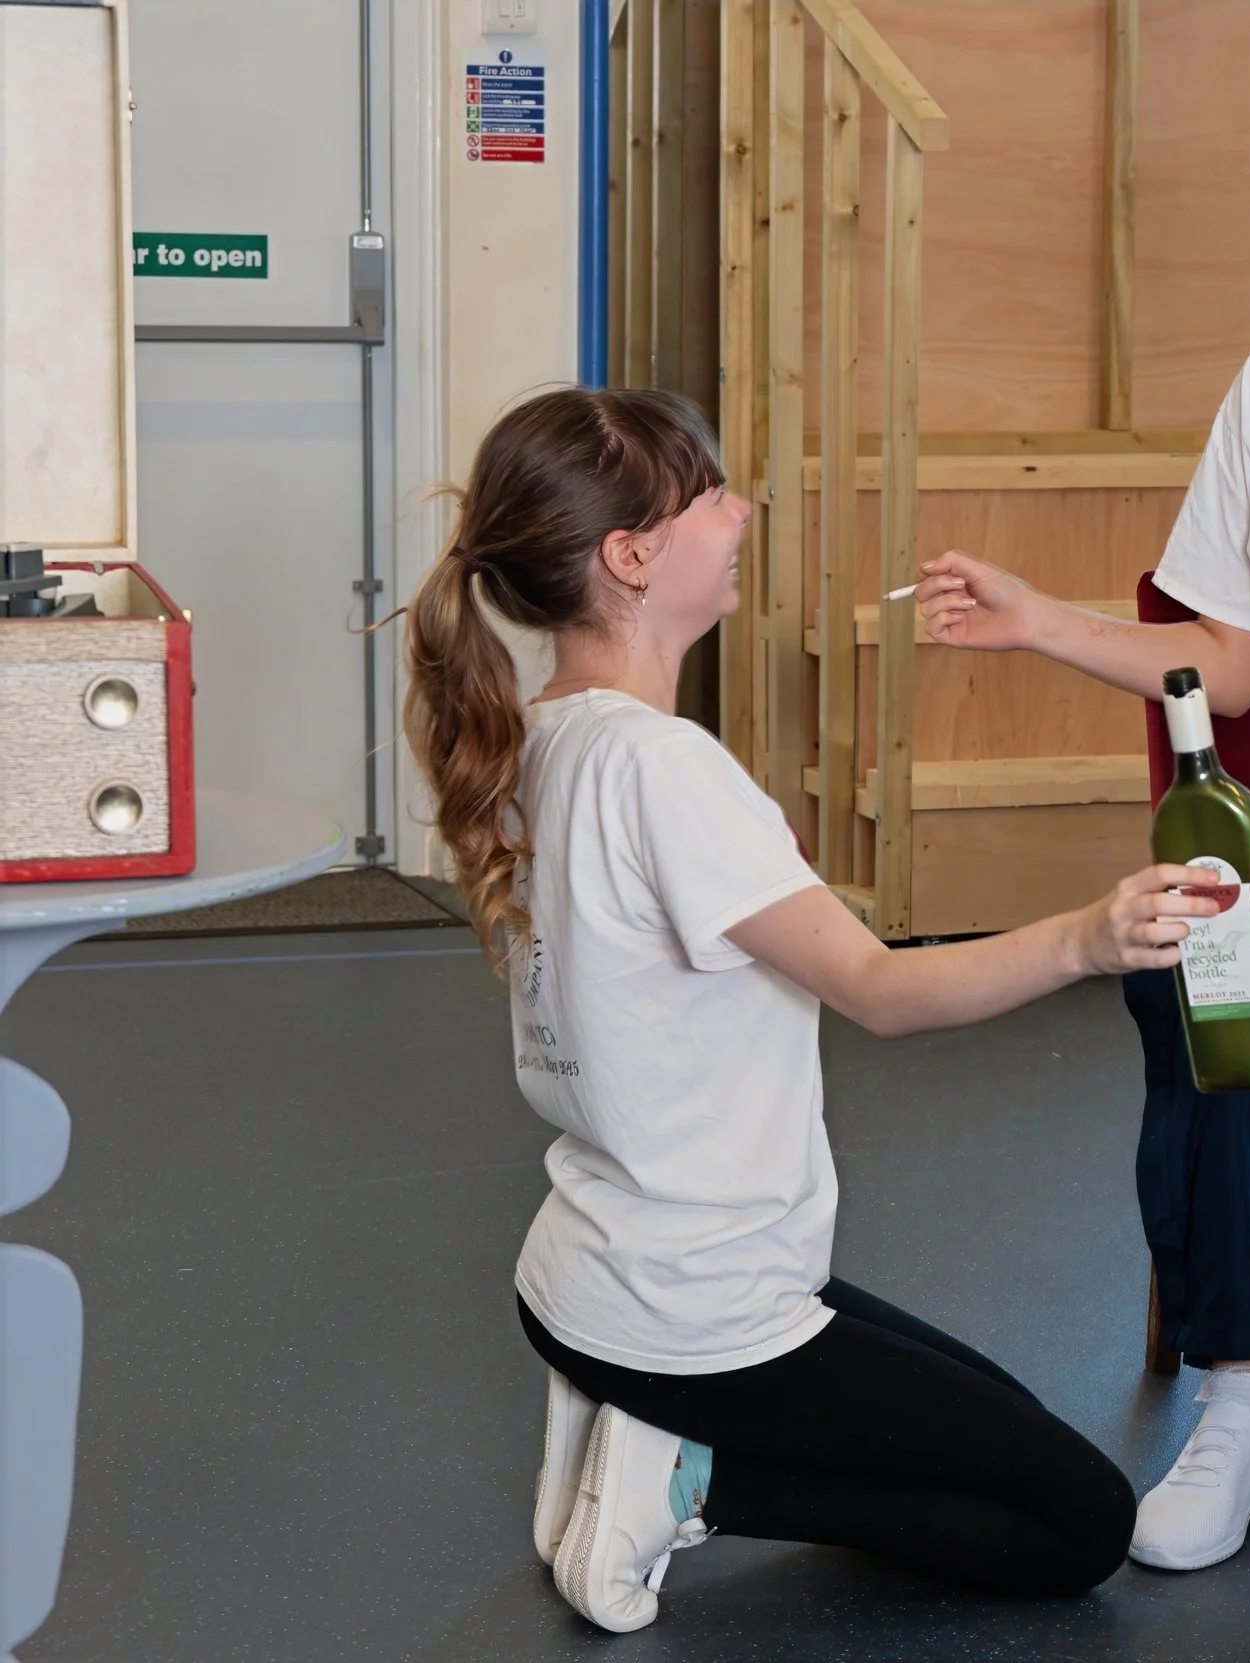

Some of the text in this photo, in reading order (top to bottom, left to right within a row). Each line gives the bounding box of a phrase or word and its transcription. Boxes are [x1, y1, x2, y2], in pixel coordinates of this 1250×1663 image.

[479, 66, 532, 77] Fire Action
[132, 244, 262, 272] r to open
[1208, 940, 1215, 949] a
[1187, 950, 1237, 968] recycled
[1188, 965, 1228, 980] bottle
